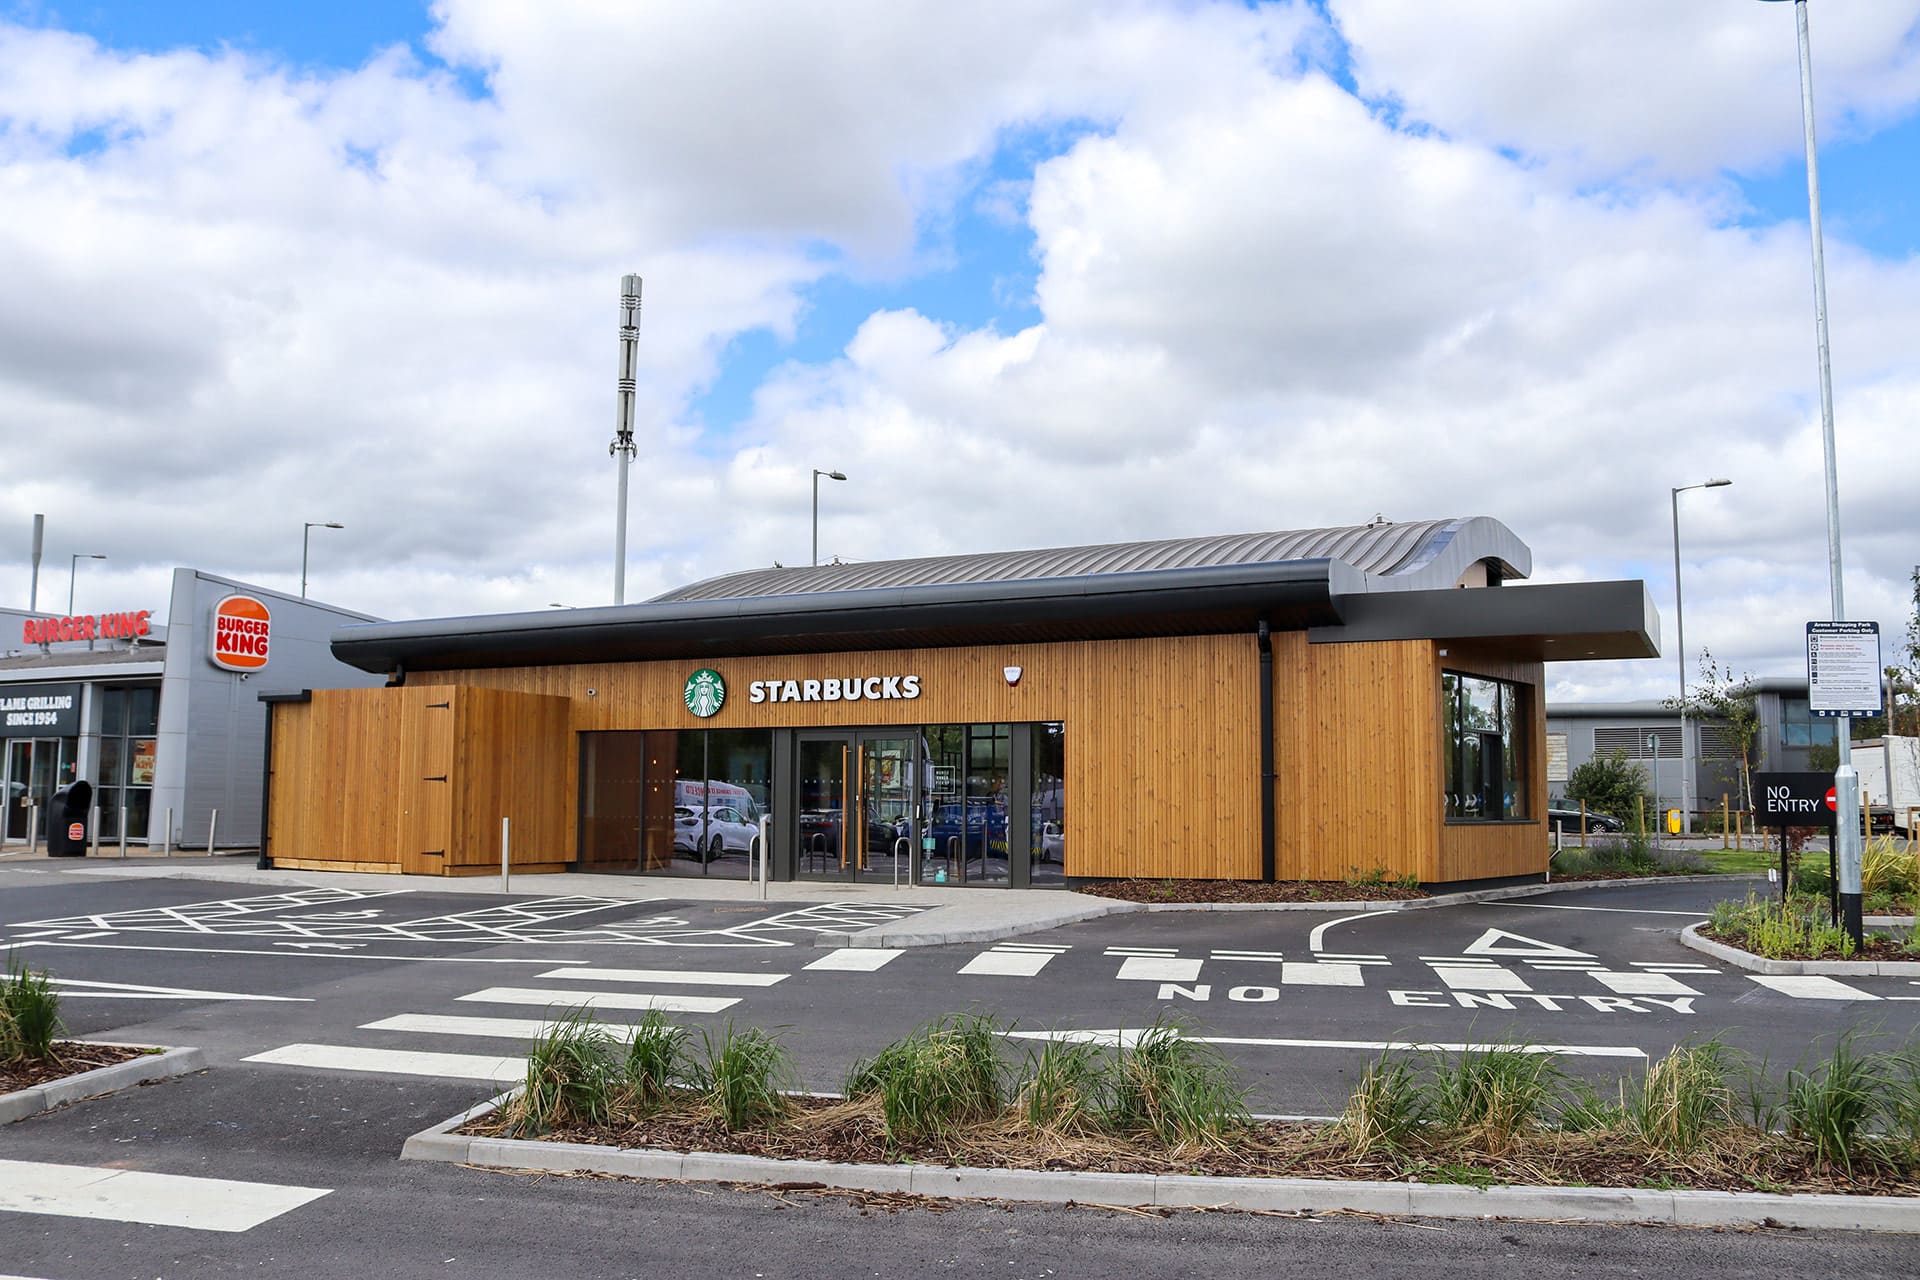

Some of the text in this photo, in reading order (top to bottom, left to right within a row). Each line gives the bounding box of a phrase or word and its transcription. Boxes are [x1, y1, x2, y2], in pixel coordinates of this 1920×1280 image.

[23, 610, 150, 644] BURGER KING
[217, 616, 269, 636] BURGER
[216, 631, 268, 656] KING
[749, 675, 920, 703] STARBUCKS
[0, 695, 72, 710] LAME GRILLING
[6, 711, 58, 726] SINCE 1954
[1767, 785, 1790, 799] NO
[1767, 799, 1820, 812] ENTRY
[1157, 983, 1697, 1014] NO ENTRY
